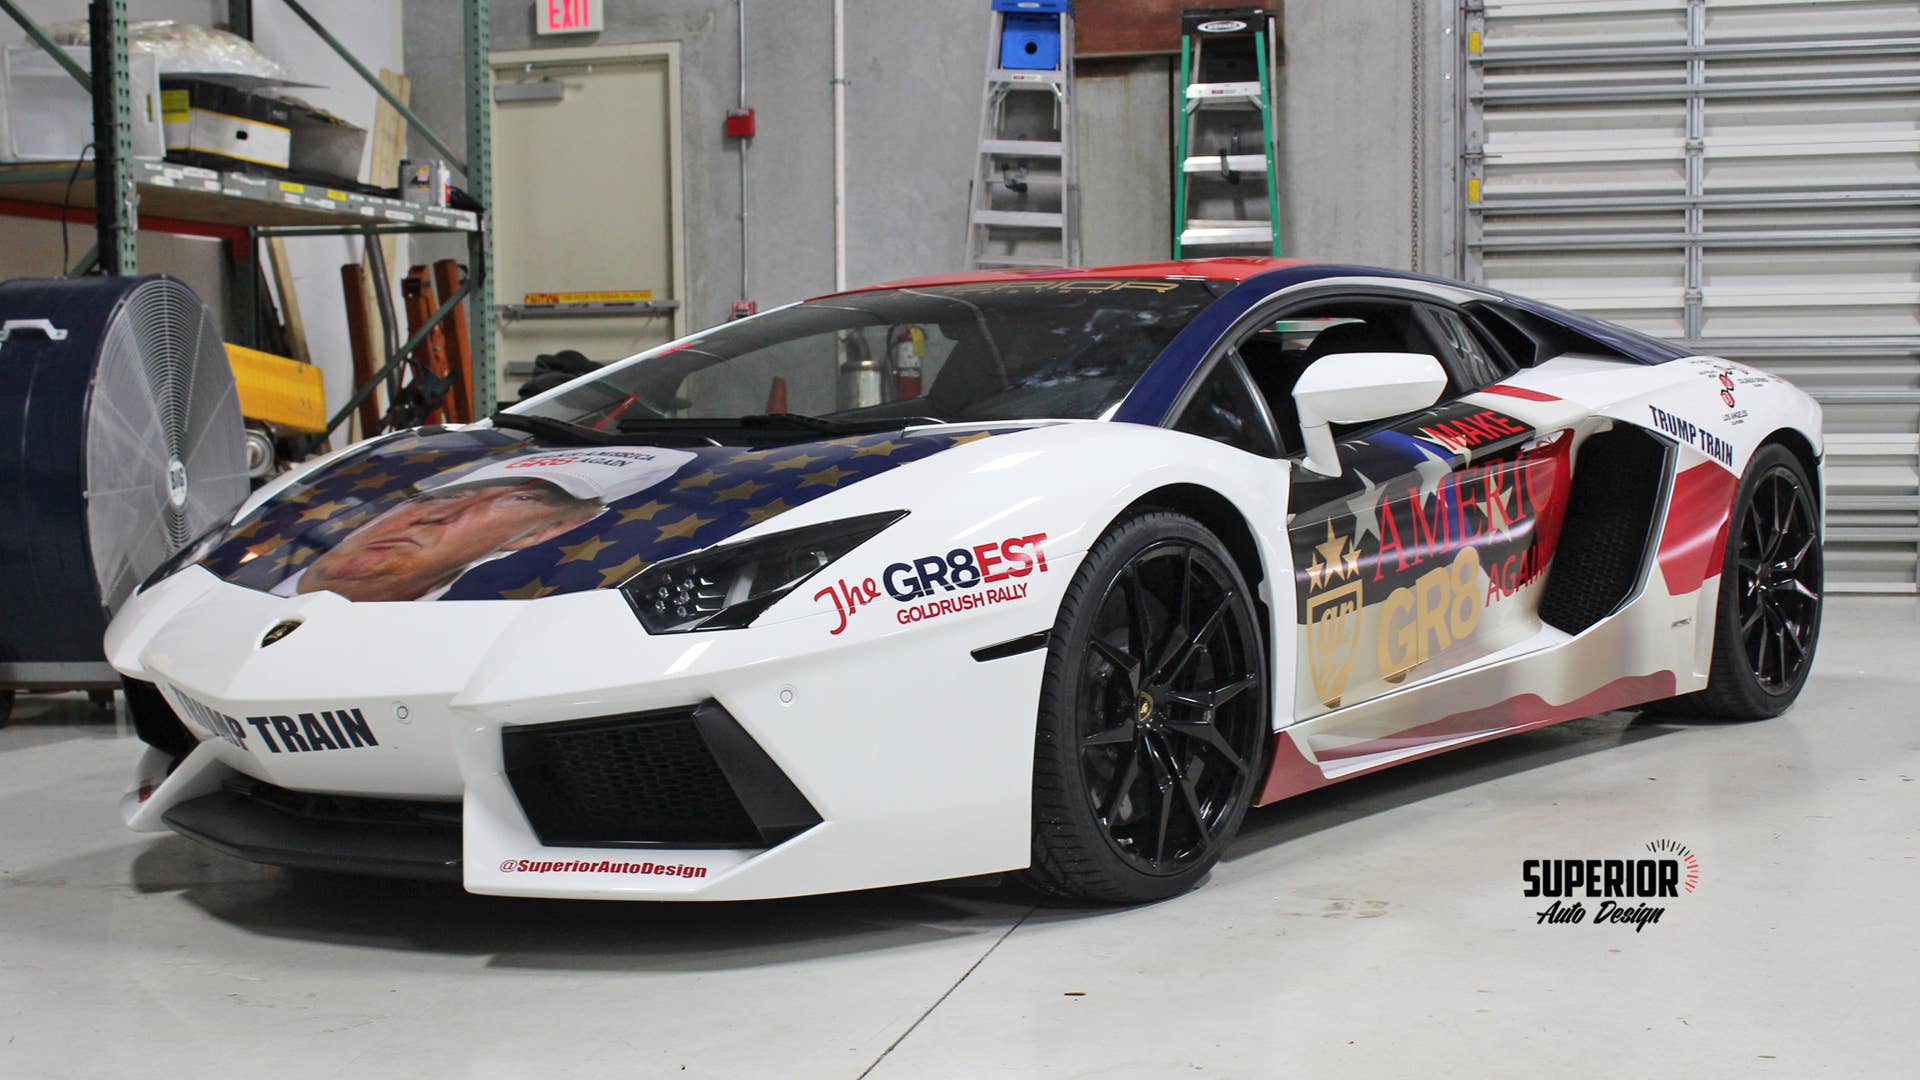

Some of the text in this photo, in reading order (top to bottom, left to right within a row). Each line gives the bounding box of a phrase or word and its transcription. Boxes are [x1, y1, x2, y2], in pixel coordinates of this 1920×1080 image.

[1421, 410, 1525, 450] MAKE
[1648, 404, 1733, 467] TRUMP TRAIN
[814, 532, 1048, 635] The GR8EST
[897, 583, 1028, 625] GOLDRUSH RALLY
[1376, 546, 1482, 684] GR8
[246, 708, 379, 753] TRAIN
[500, 859, 707, 878] @SuperiorAutoDesign
